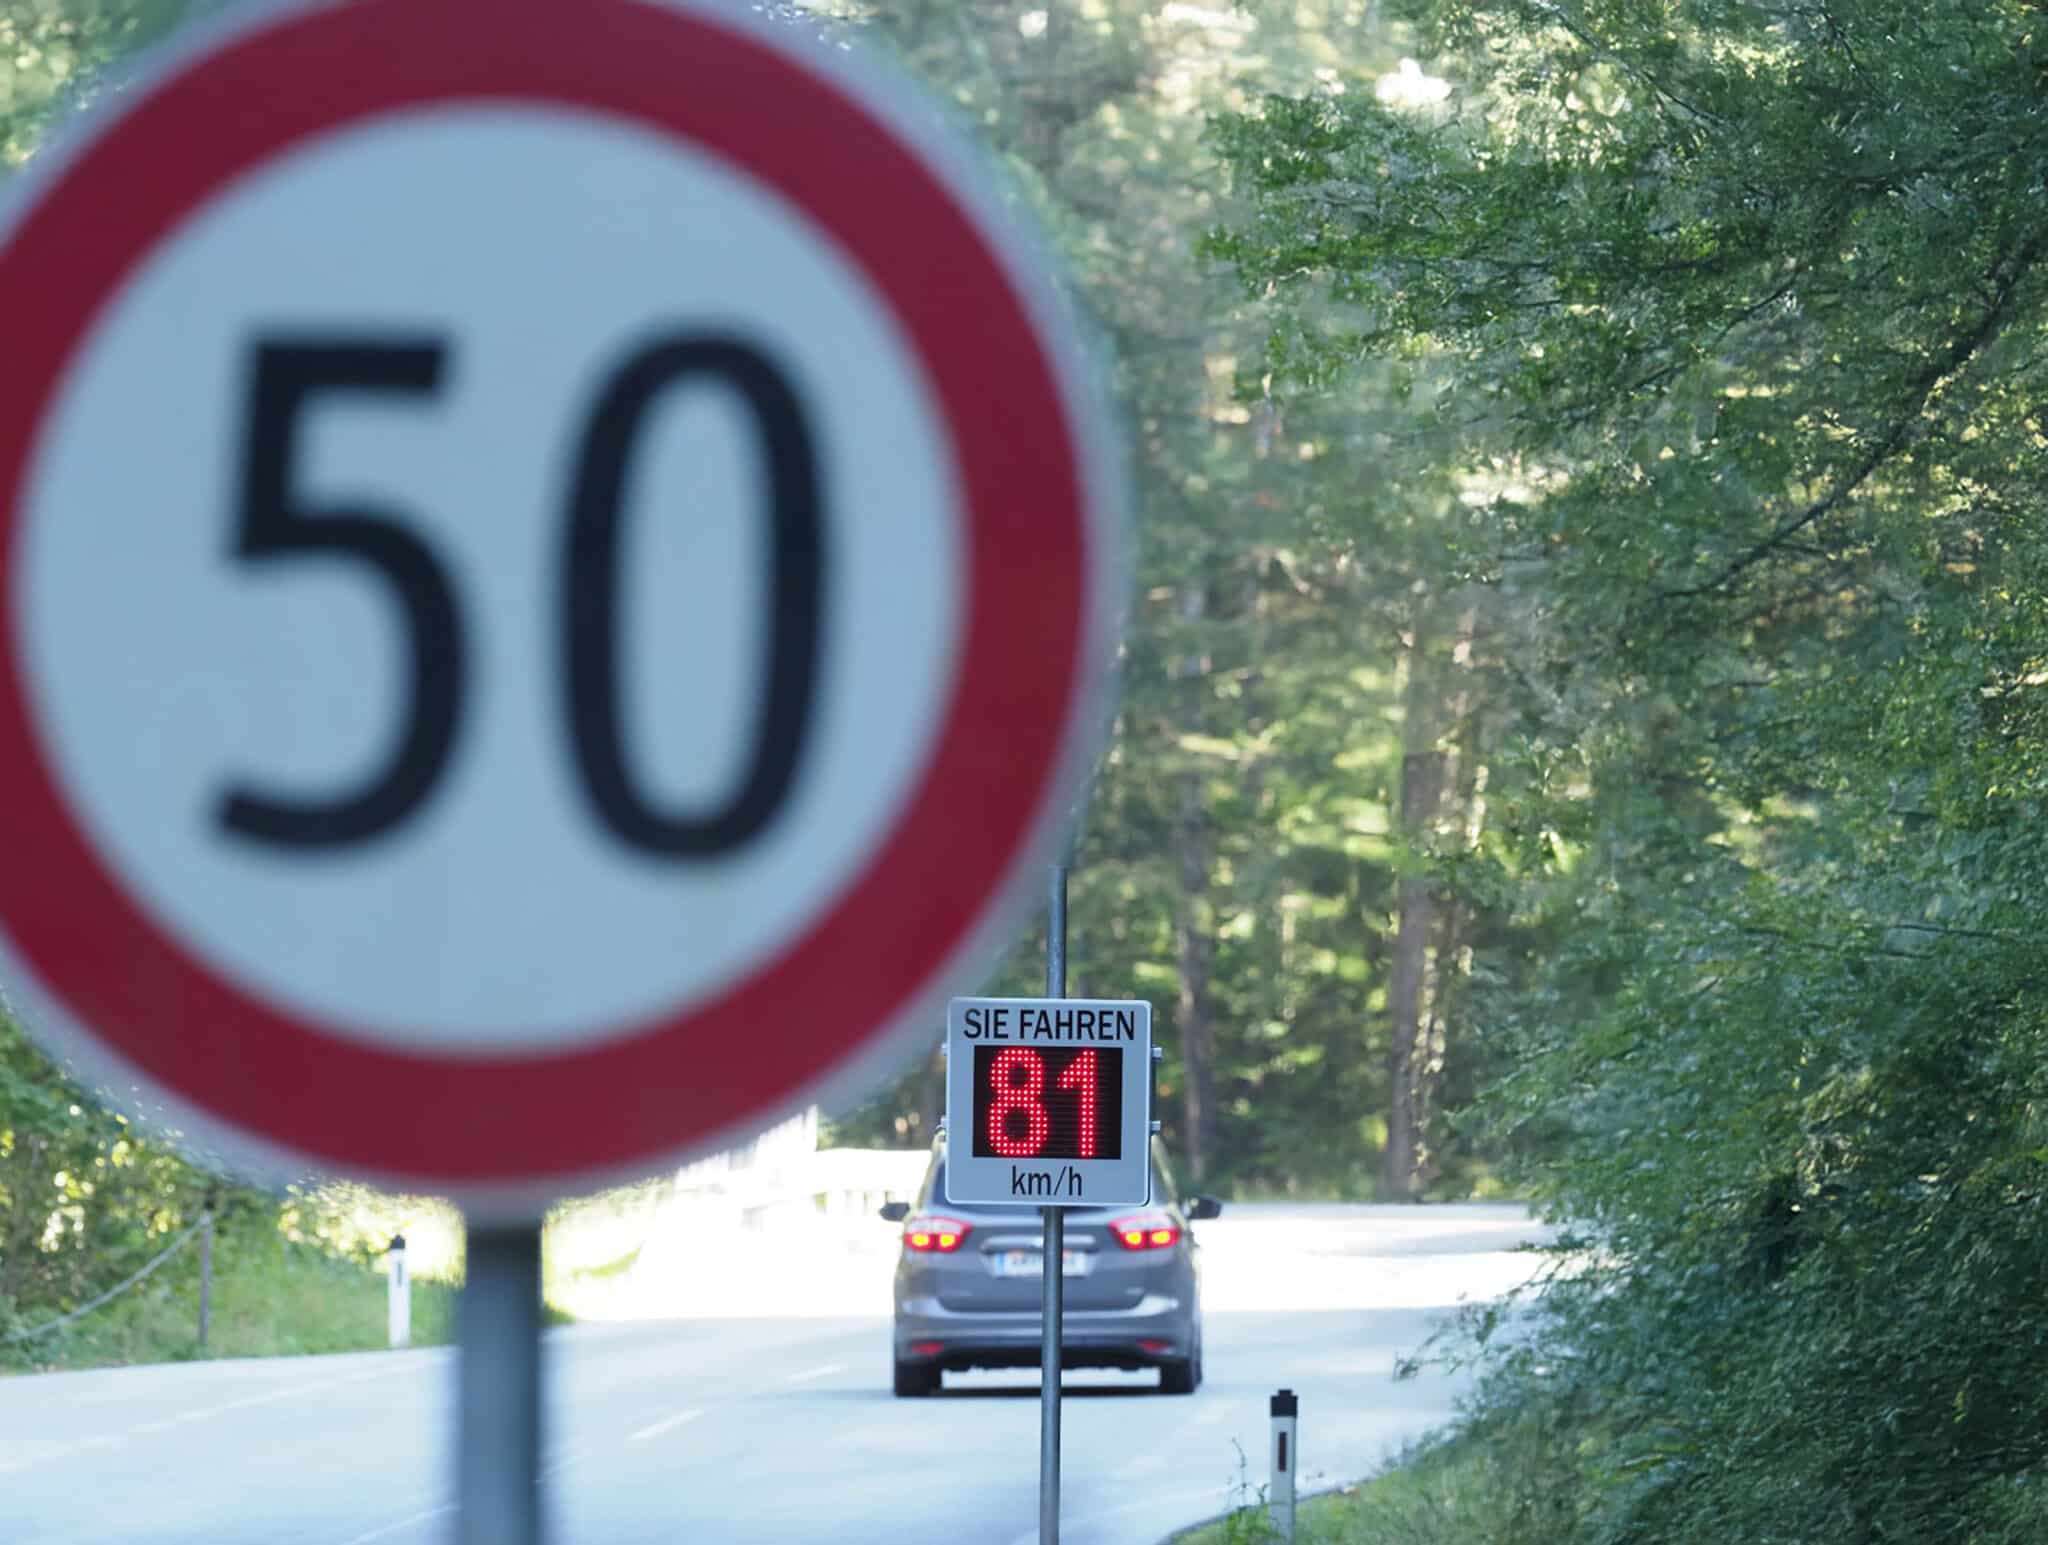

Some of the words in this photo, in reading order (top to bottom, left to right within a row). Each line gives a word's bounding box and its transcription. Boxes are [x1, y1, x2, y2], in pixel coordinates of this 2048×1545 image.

[212, 325, 833, 863] 50
[963, 1008, 1009, 1039] SIE
[1019, 1009, 1135, 1041] FAHREN
[988, 1047, 1097, 1157] 81
[1011, 1164, 1083, 1196] km/h
